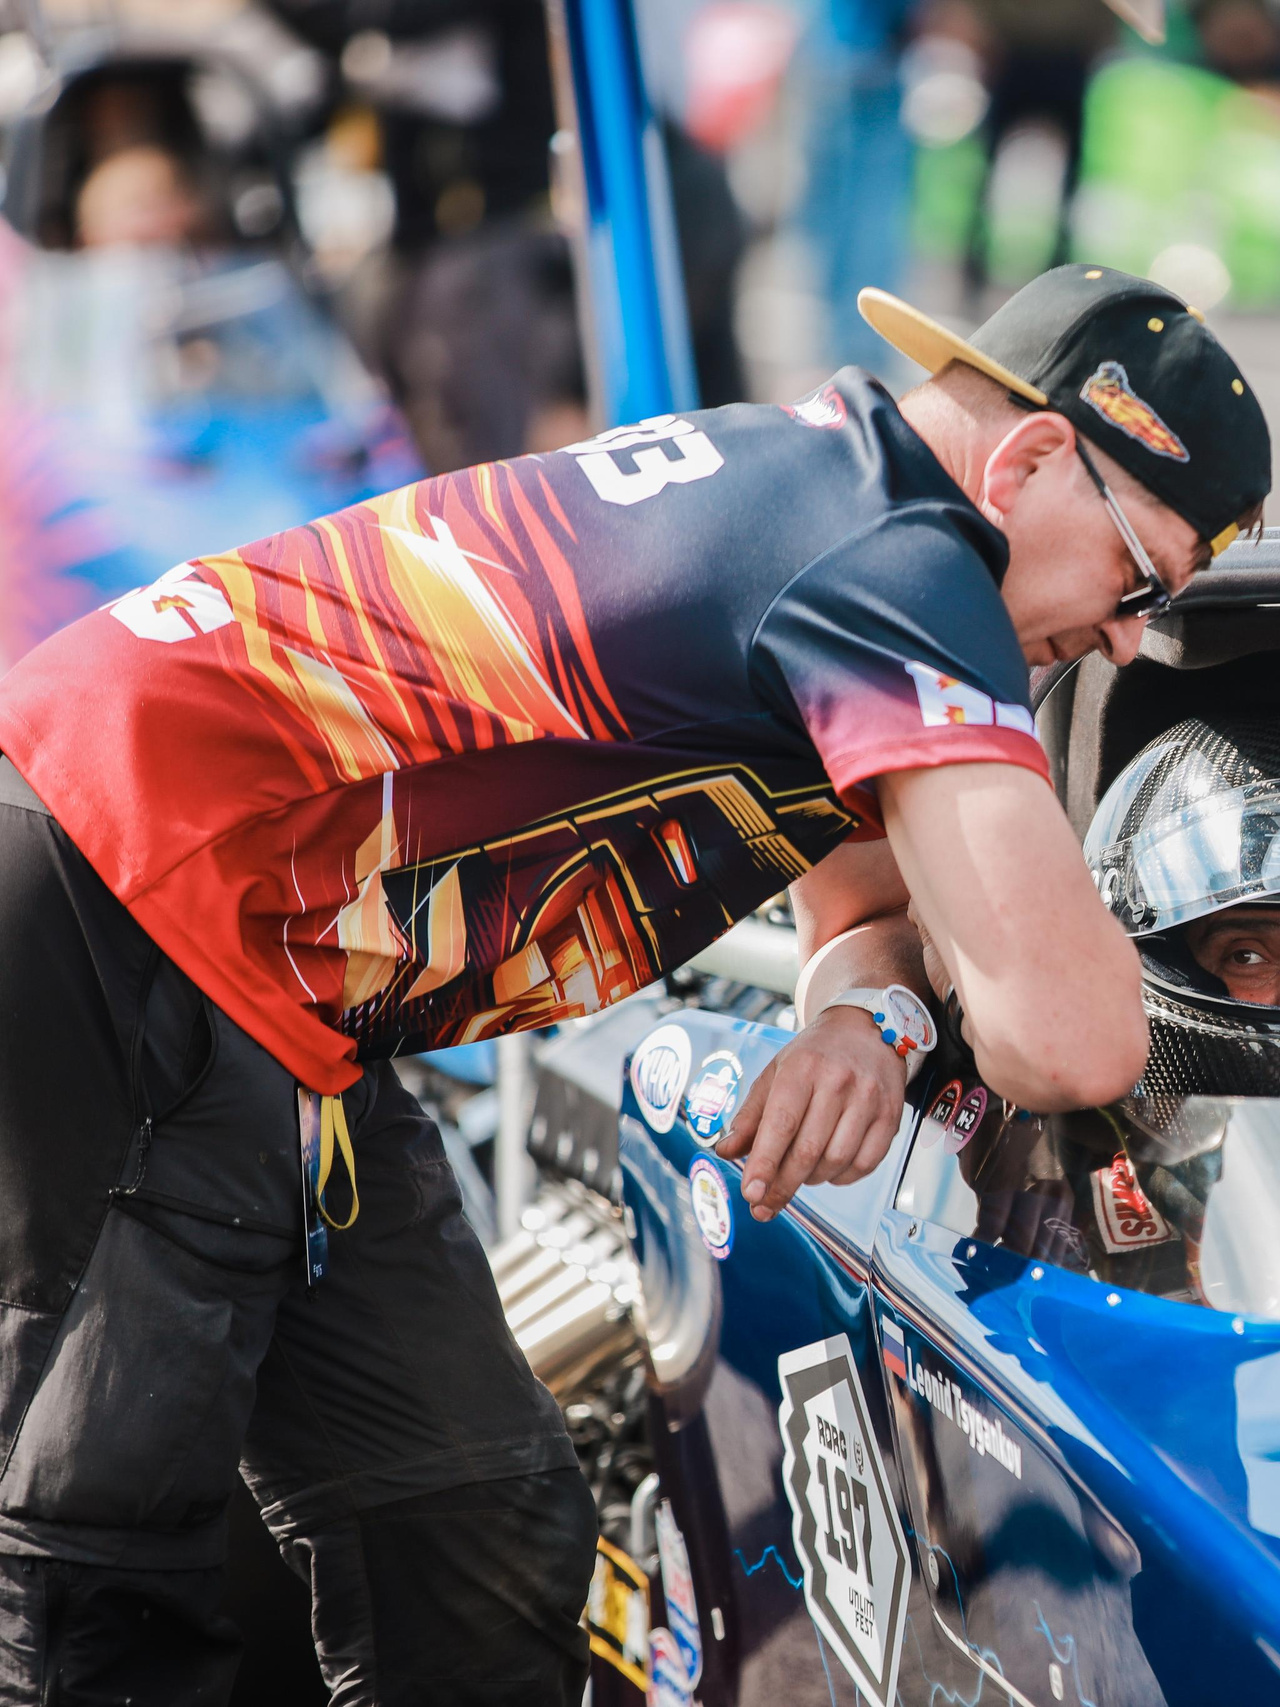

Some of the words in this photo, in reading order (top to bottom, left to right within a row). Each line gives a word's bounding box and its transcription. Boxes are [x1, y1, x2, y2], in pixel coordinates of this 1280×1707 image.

[906, 1345, 954, 1421] Leonid
[816, 1454, 874, 1588] 197
[854, 1610, 874, 1640] FEST
